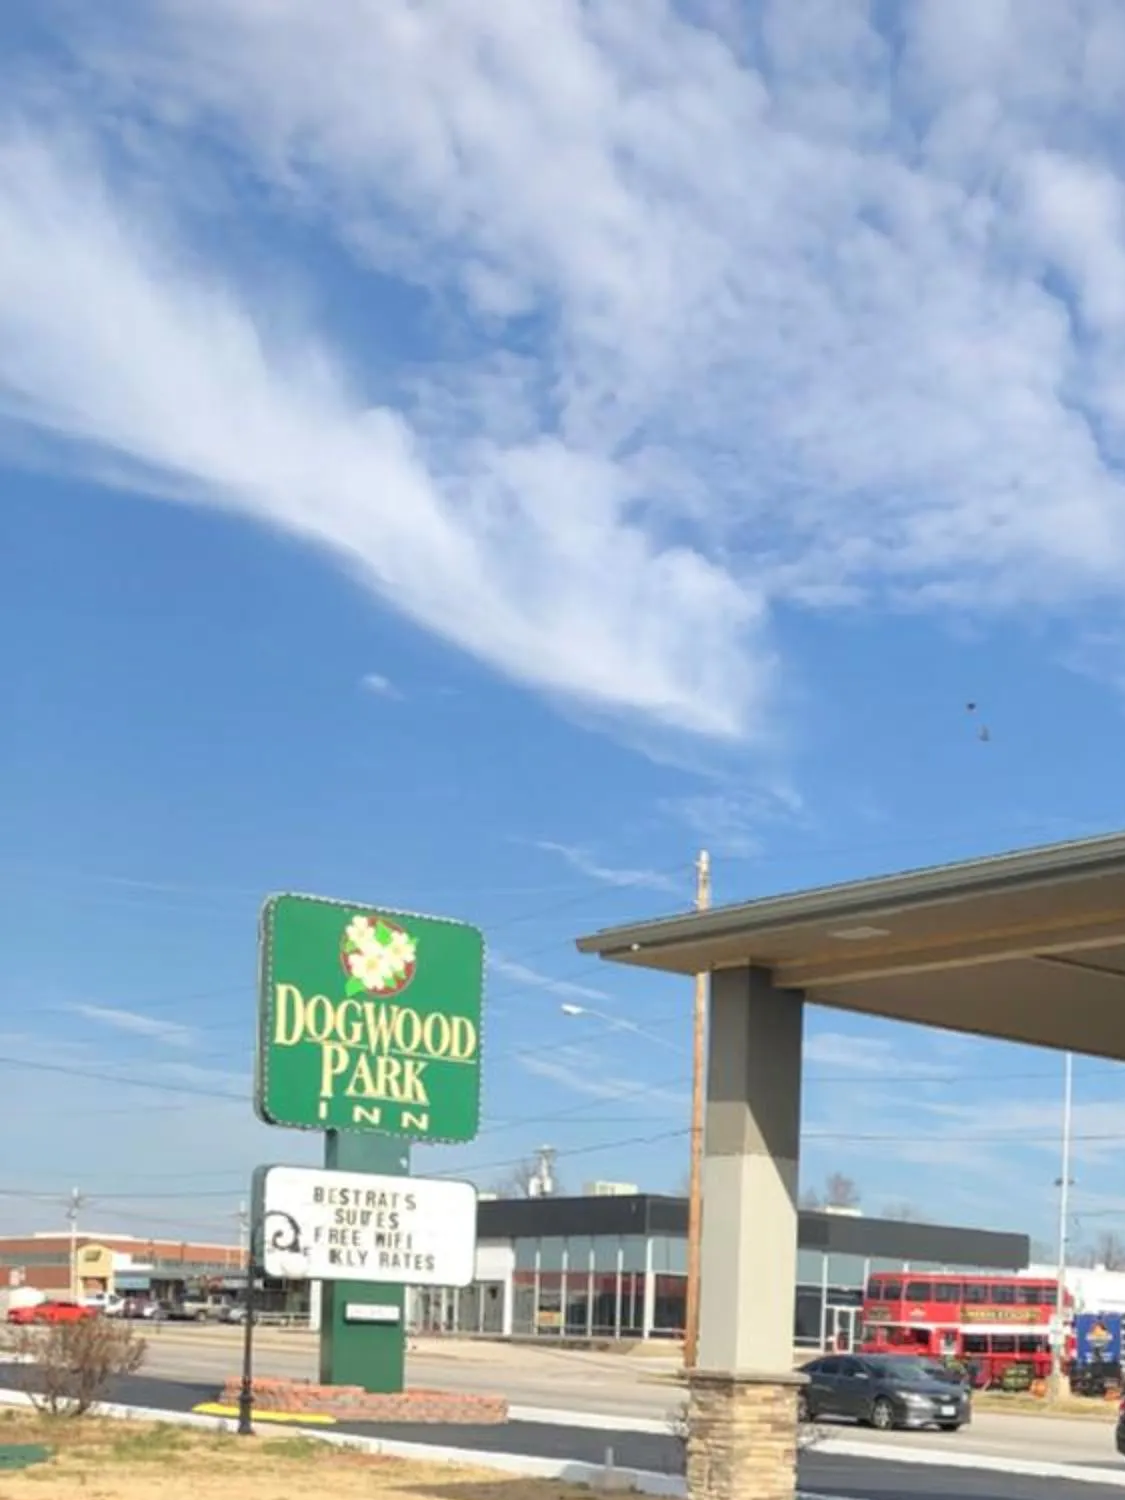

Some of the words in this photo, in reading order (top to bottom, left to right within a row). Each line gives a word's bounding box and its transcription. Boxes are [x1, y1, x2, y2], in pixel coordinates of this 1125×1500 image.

[274, 983, 477, 1062] DOGWOOD
[320, 1043, 430, 1106] PARK
[379, 1251, 436, 1272] RATES
